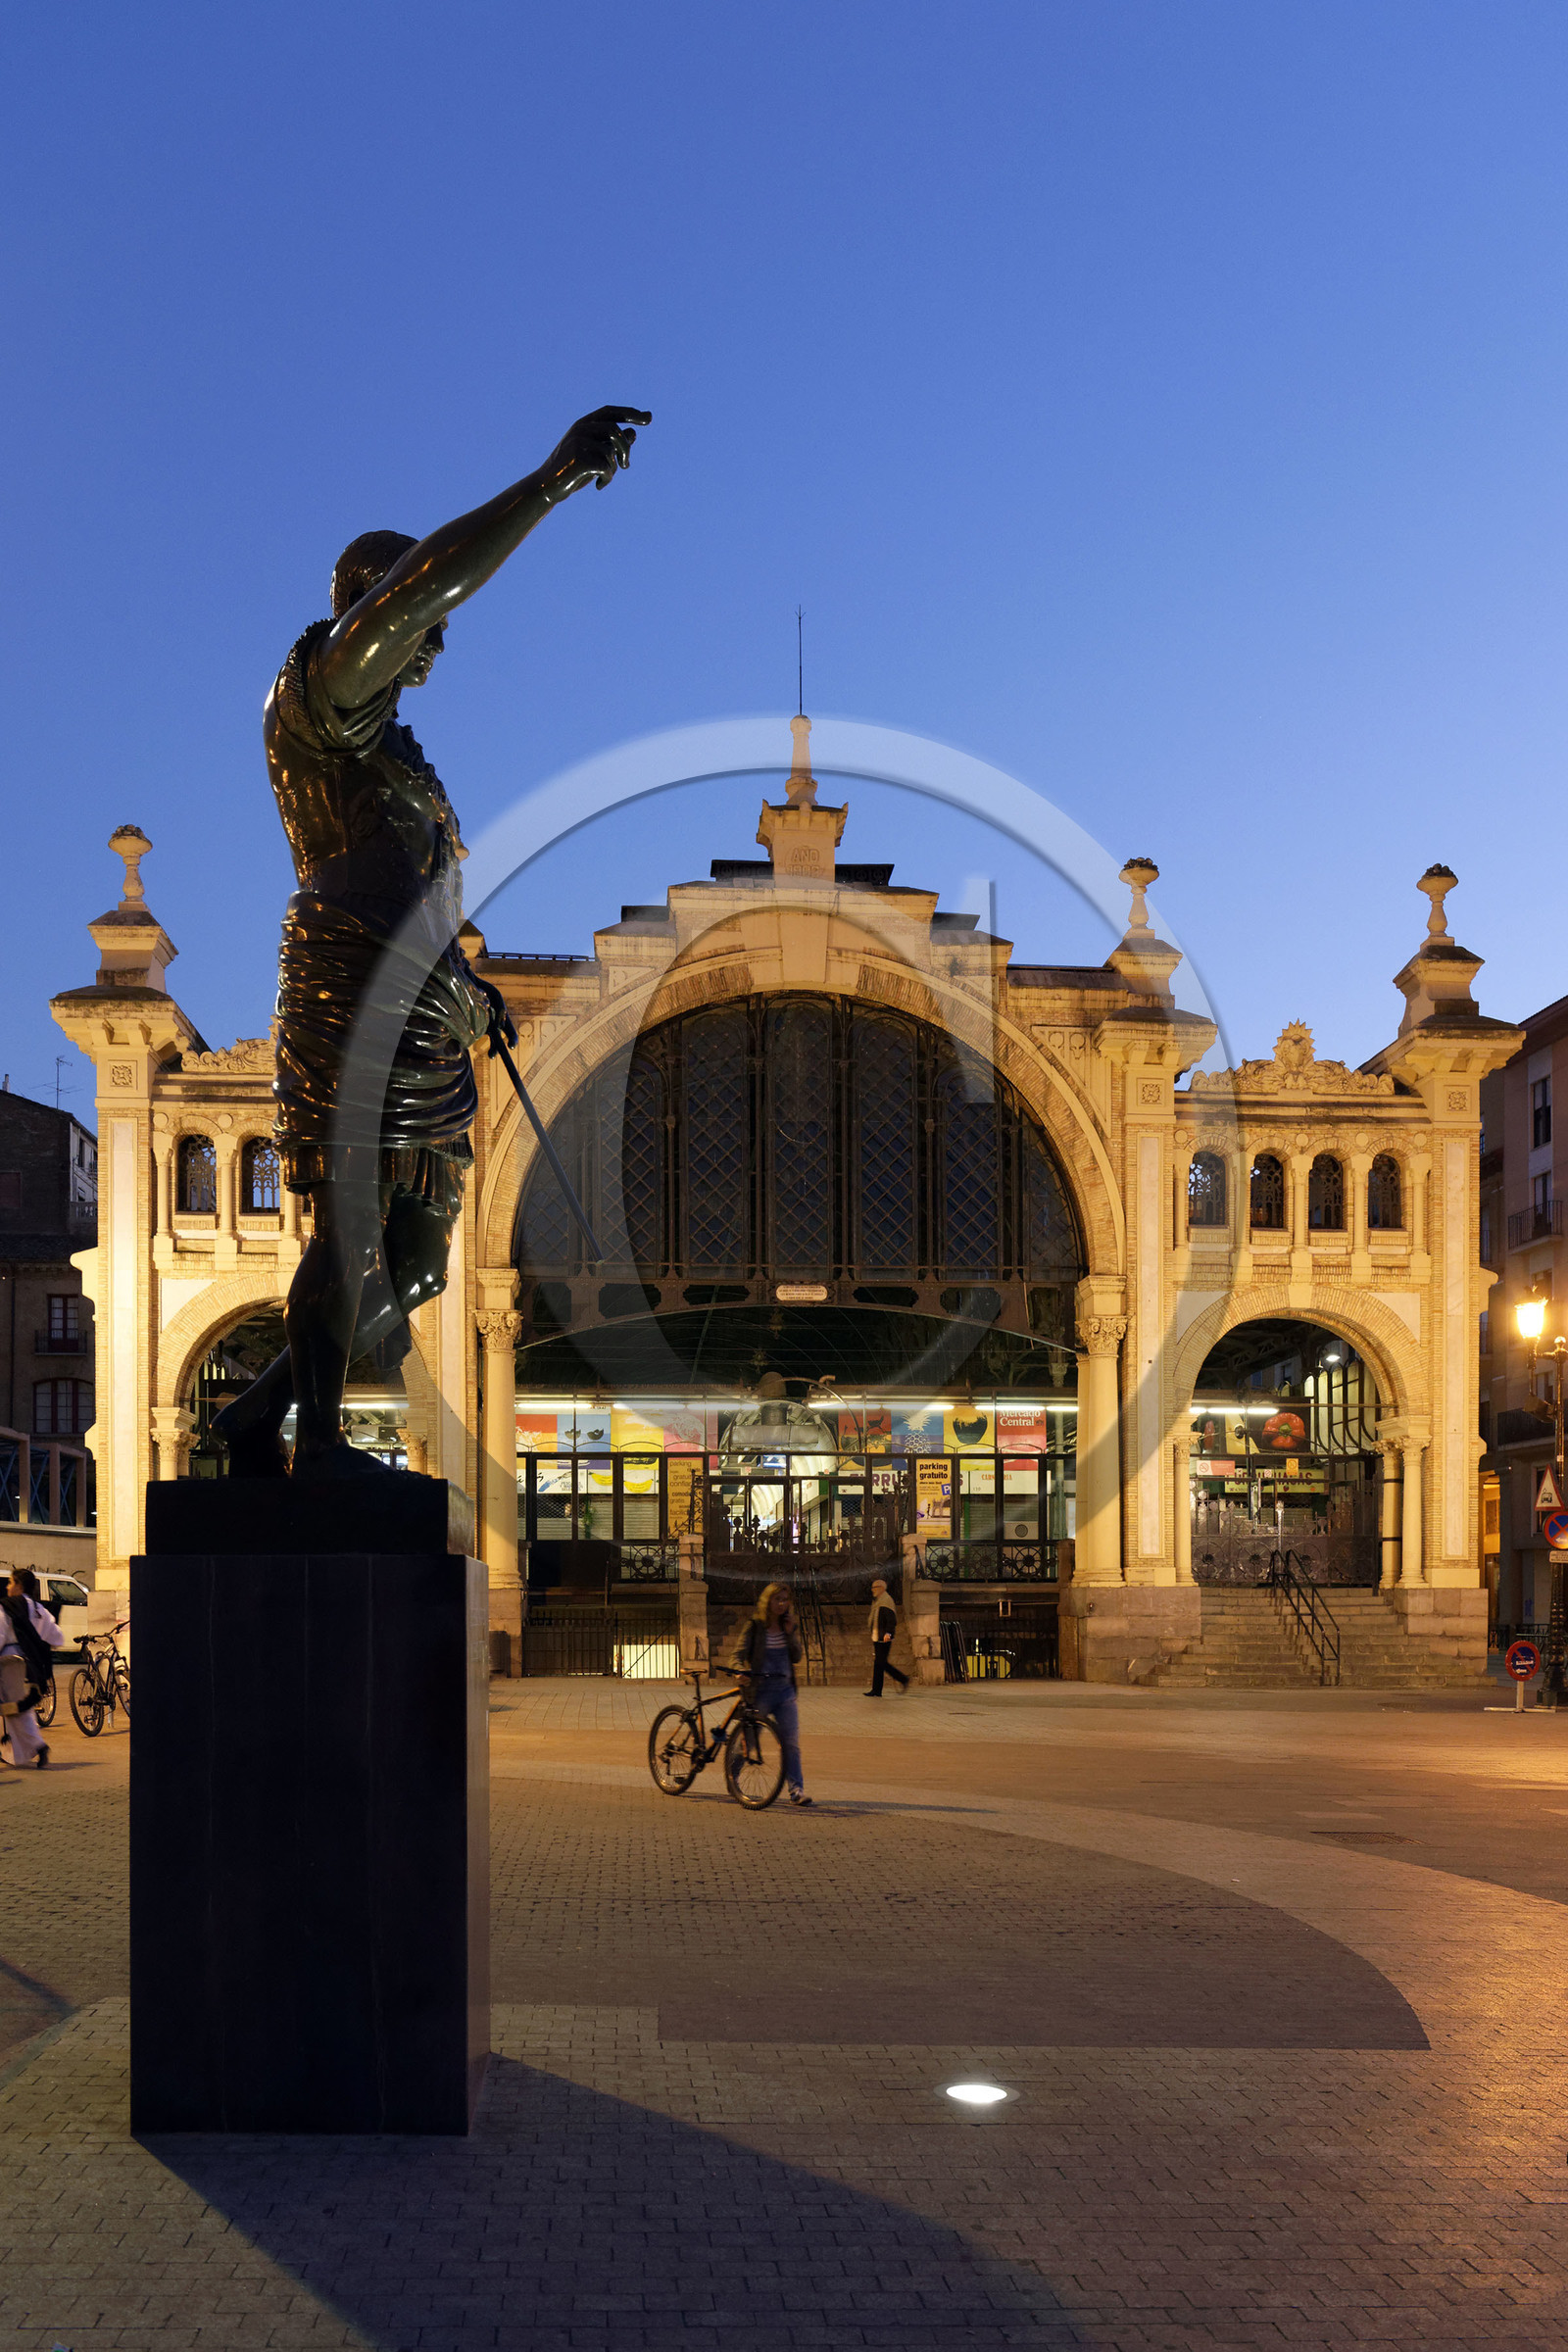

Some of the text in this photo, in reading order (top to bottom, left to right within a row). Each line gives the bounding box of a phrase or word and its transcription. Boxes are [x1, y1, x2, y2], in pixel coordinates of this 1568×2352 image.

[1000, 1417, 1035, 1427] Central
[919, 1462, 949, 1472] parking
[919, 1471, 949, 1481] gratuito
